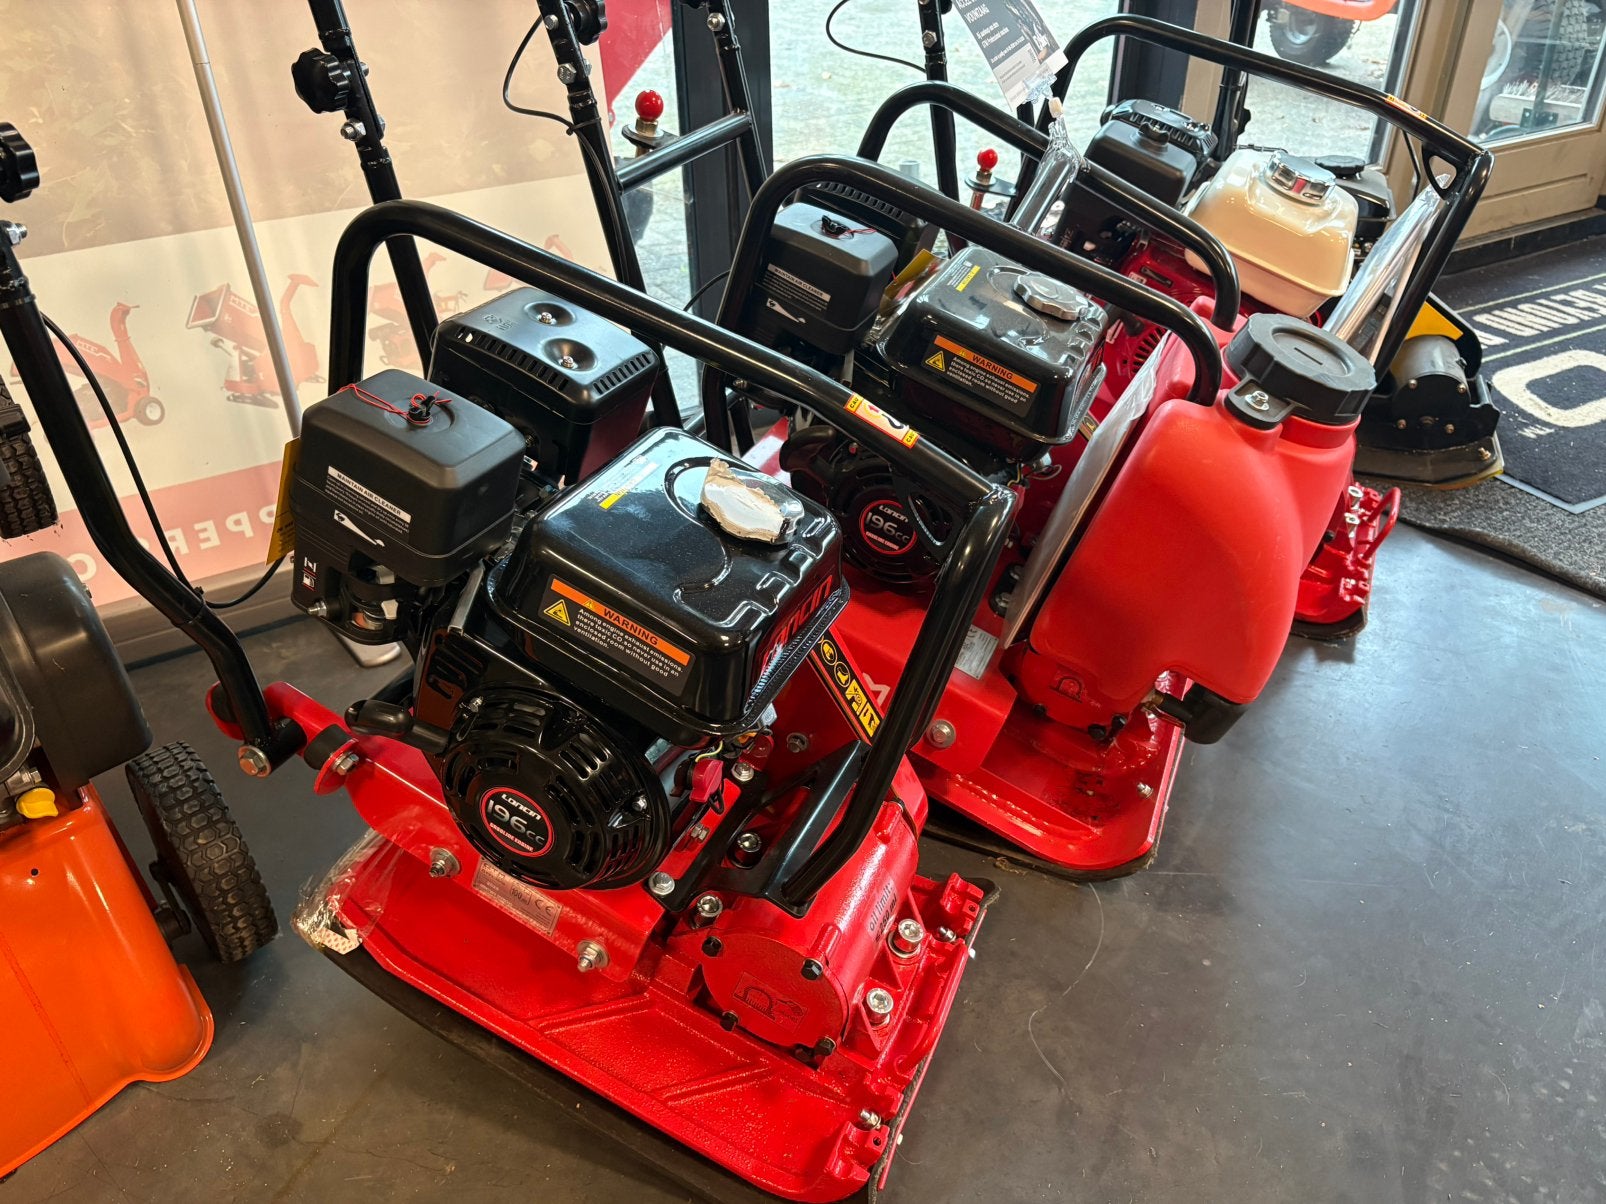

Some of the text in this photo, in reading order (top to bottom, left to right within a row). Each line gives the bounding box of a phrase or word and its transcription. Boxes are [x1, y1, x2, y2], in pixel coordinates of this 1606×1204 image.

[972, 354, 1013, 380] WARNING
[337, 472, 401, 516] MAINTAIN AIR CLEANER
[573, 626, 609, 649] ventilation.
[577, 614, 595, 627] there
[595, 624, 611, 636] toxic
[632, 646, 651, 659] never
[651, 657, 663, 667] use
[663, 664, 670, 672] in
[579, 608, 683, 673] Among engine exhaust emissions.
[603, 608, 658, 646] WARNING
[575, 620, 669, 677] enclosed room without good
[869, 910, 879, 931] oil
